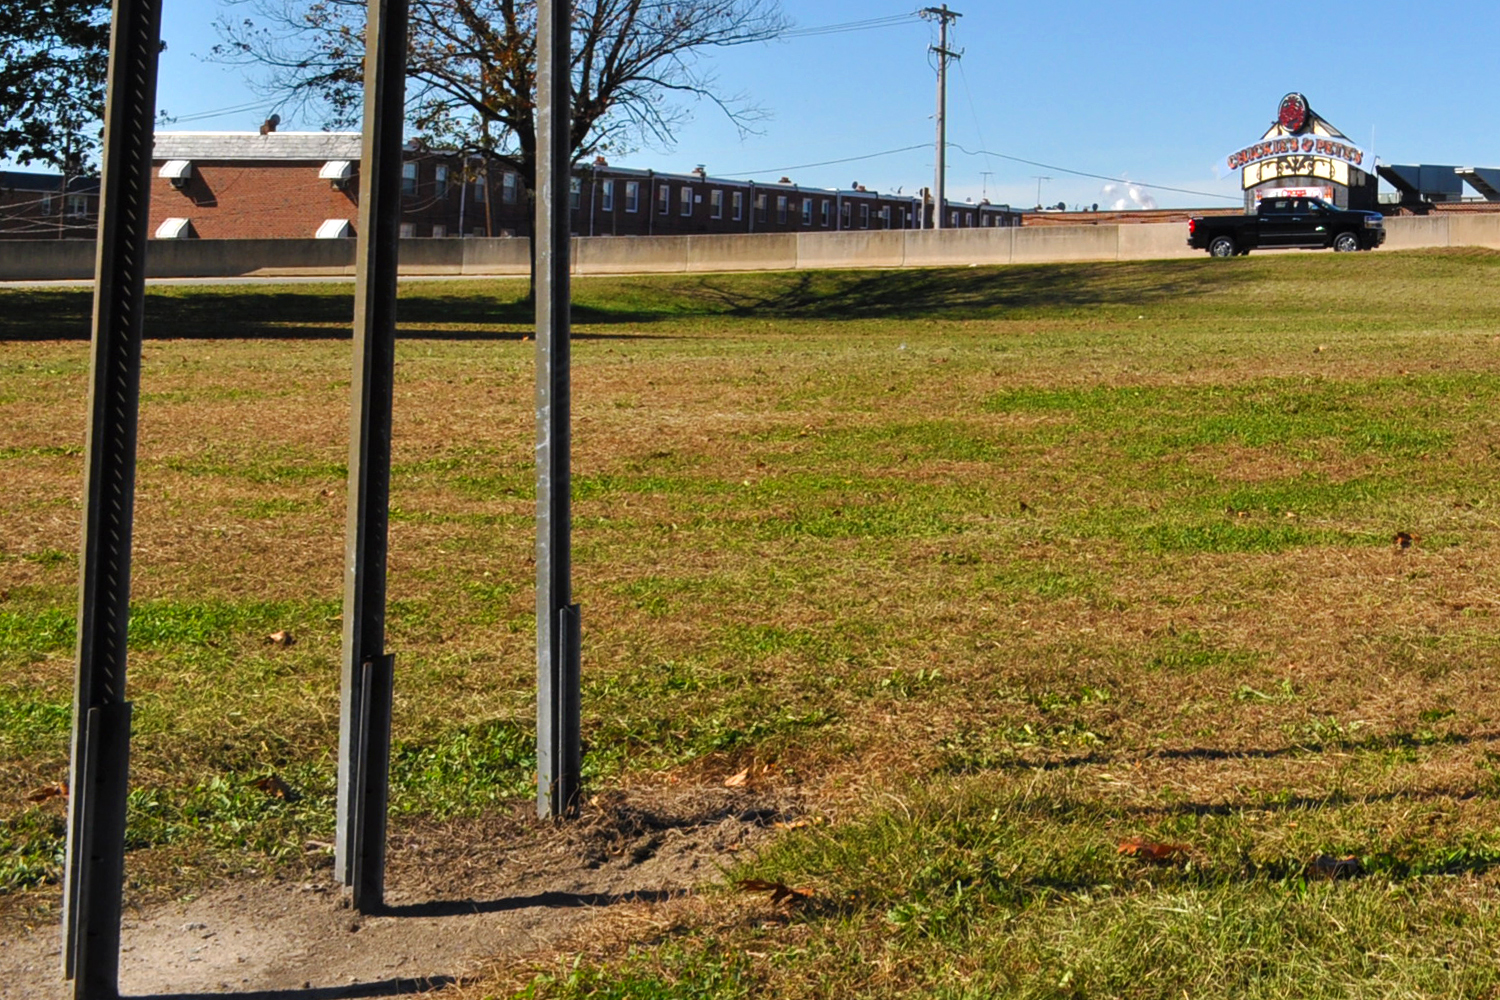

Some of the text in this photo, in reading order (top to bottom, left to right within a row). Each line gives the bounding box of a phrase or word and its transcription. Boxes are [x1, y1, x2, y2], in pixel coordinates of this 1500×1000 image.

[1227, 137, 1364, 170] CHICKIE'S & PETE'S
